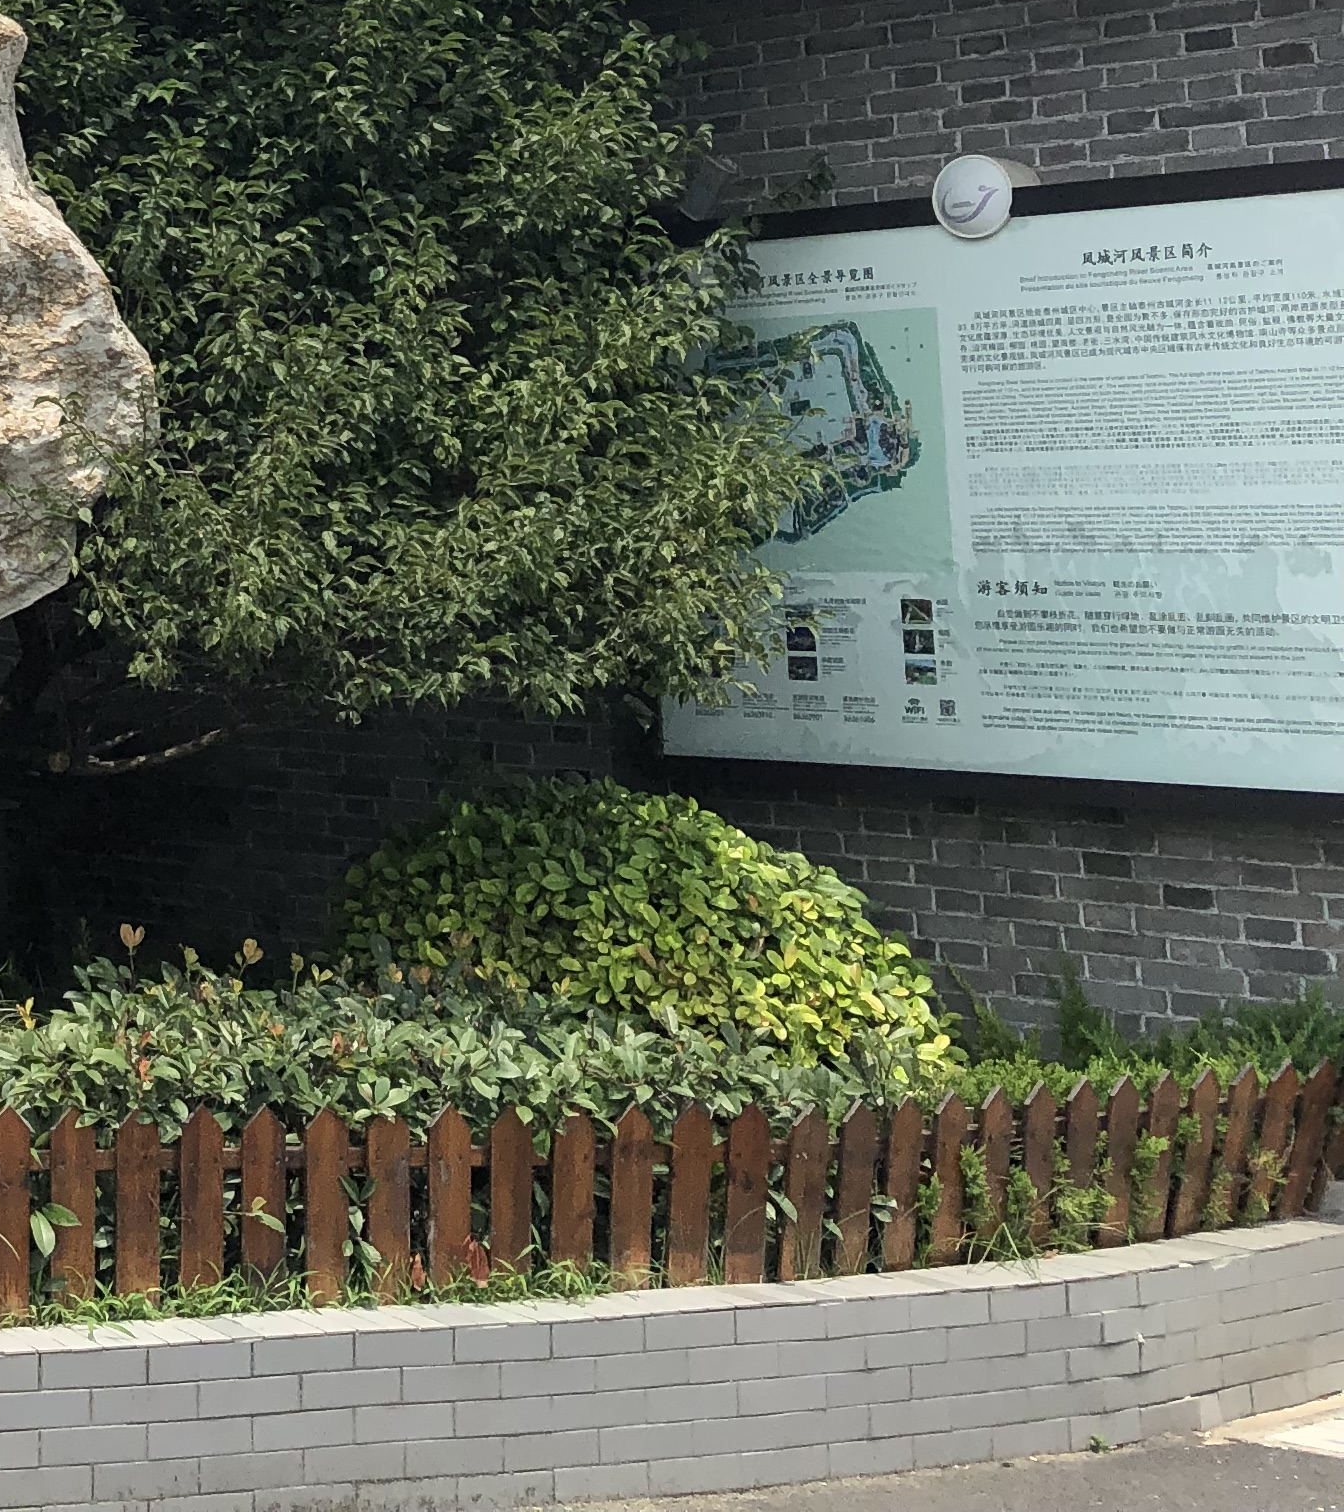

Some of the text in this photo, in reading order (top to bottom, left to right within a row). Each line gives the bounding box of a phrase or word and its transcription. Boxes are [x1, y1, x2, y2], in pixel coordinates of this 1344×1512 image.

[1082, 242, 1212, 266] 凤城河风景区简介
[977, 579, 1048, 597] 游客须知
